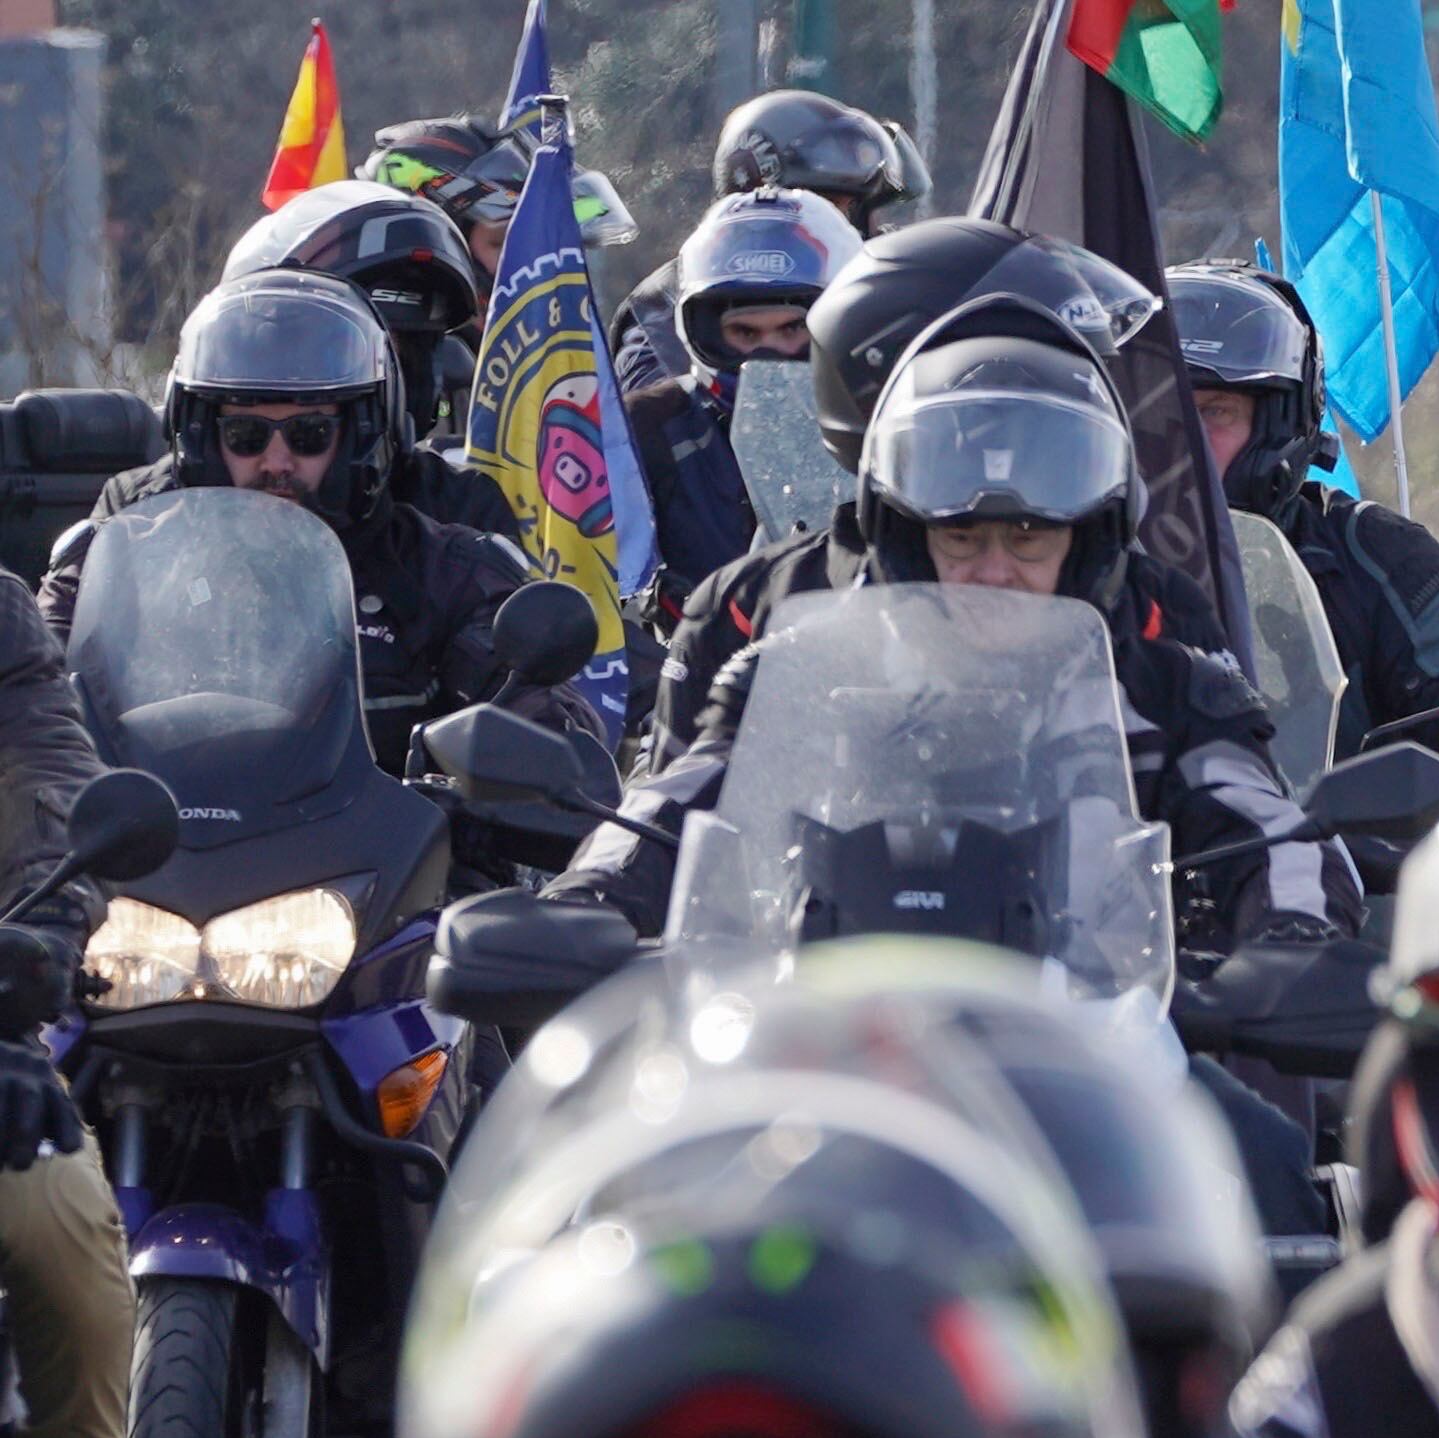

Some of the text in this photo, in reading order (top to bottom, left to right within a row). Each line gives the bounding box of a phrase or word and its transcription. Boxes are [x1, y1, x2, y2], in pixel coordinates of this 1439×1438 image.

[734, 254, 786, 273] SHOEI
[477, 320, 541, 412] FOLL
[178, 807, 242, 821] ONDA
